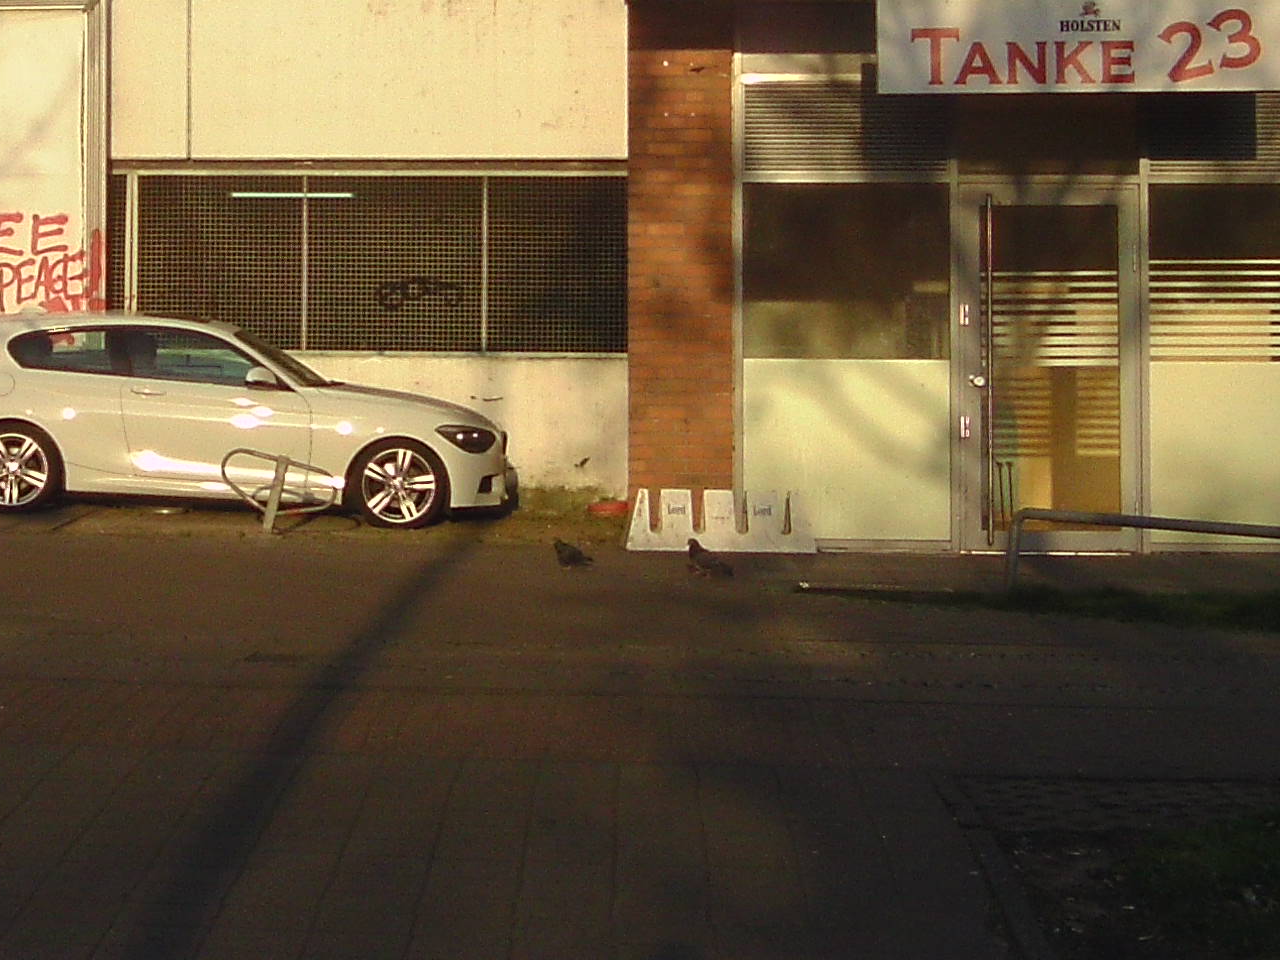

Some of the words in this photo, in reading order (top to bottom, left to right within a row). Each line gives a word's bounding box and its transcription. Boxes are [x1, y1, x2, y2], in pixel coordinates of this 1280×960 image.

[911, 27, 1135, 86] TANKE
[1157, 8, 1262, 83] 23
[1060, 19, 1121, 32] HOLSTEN
